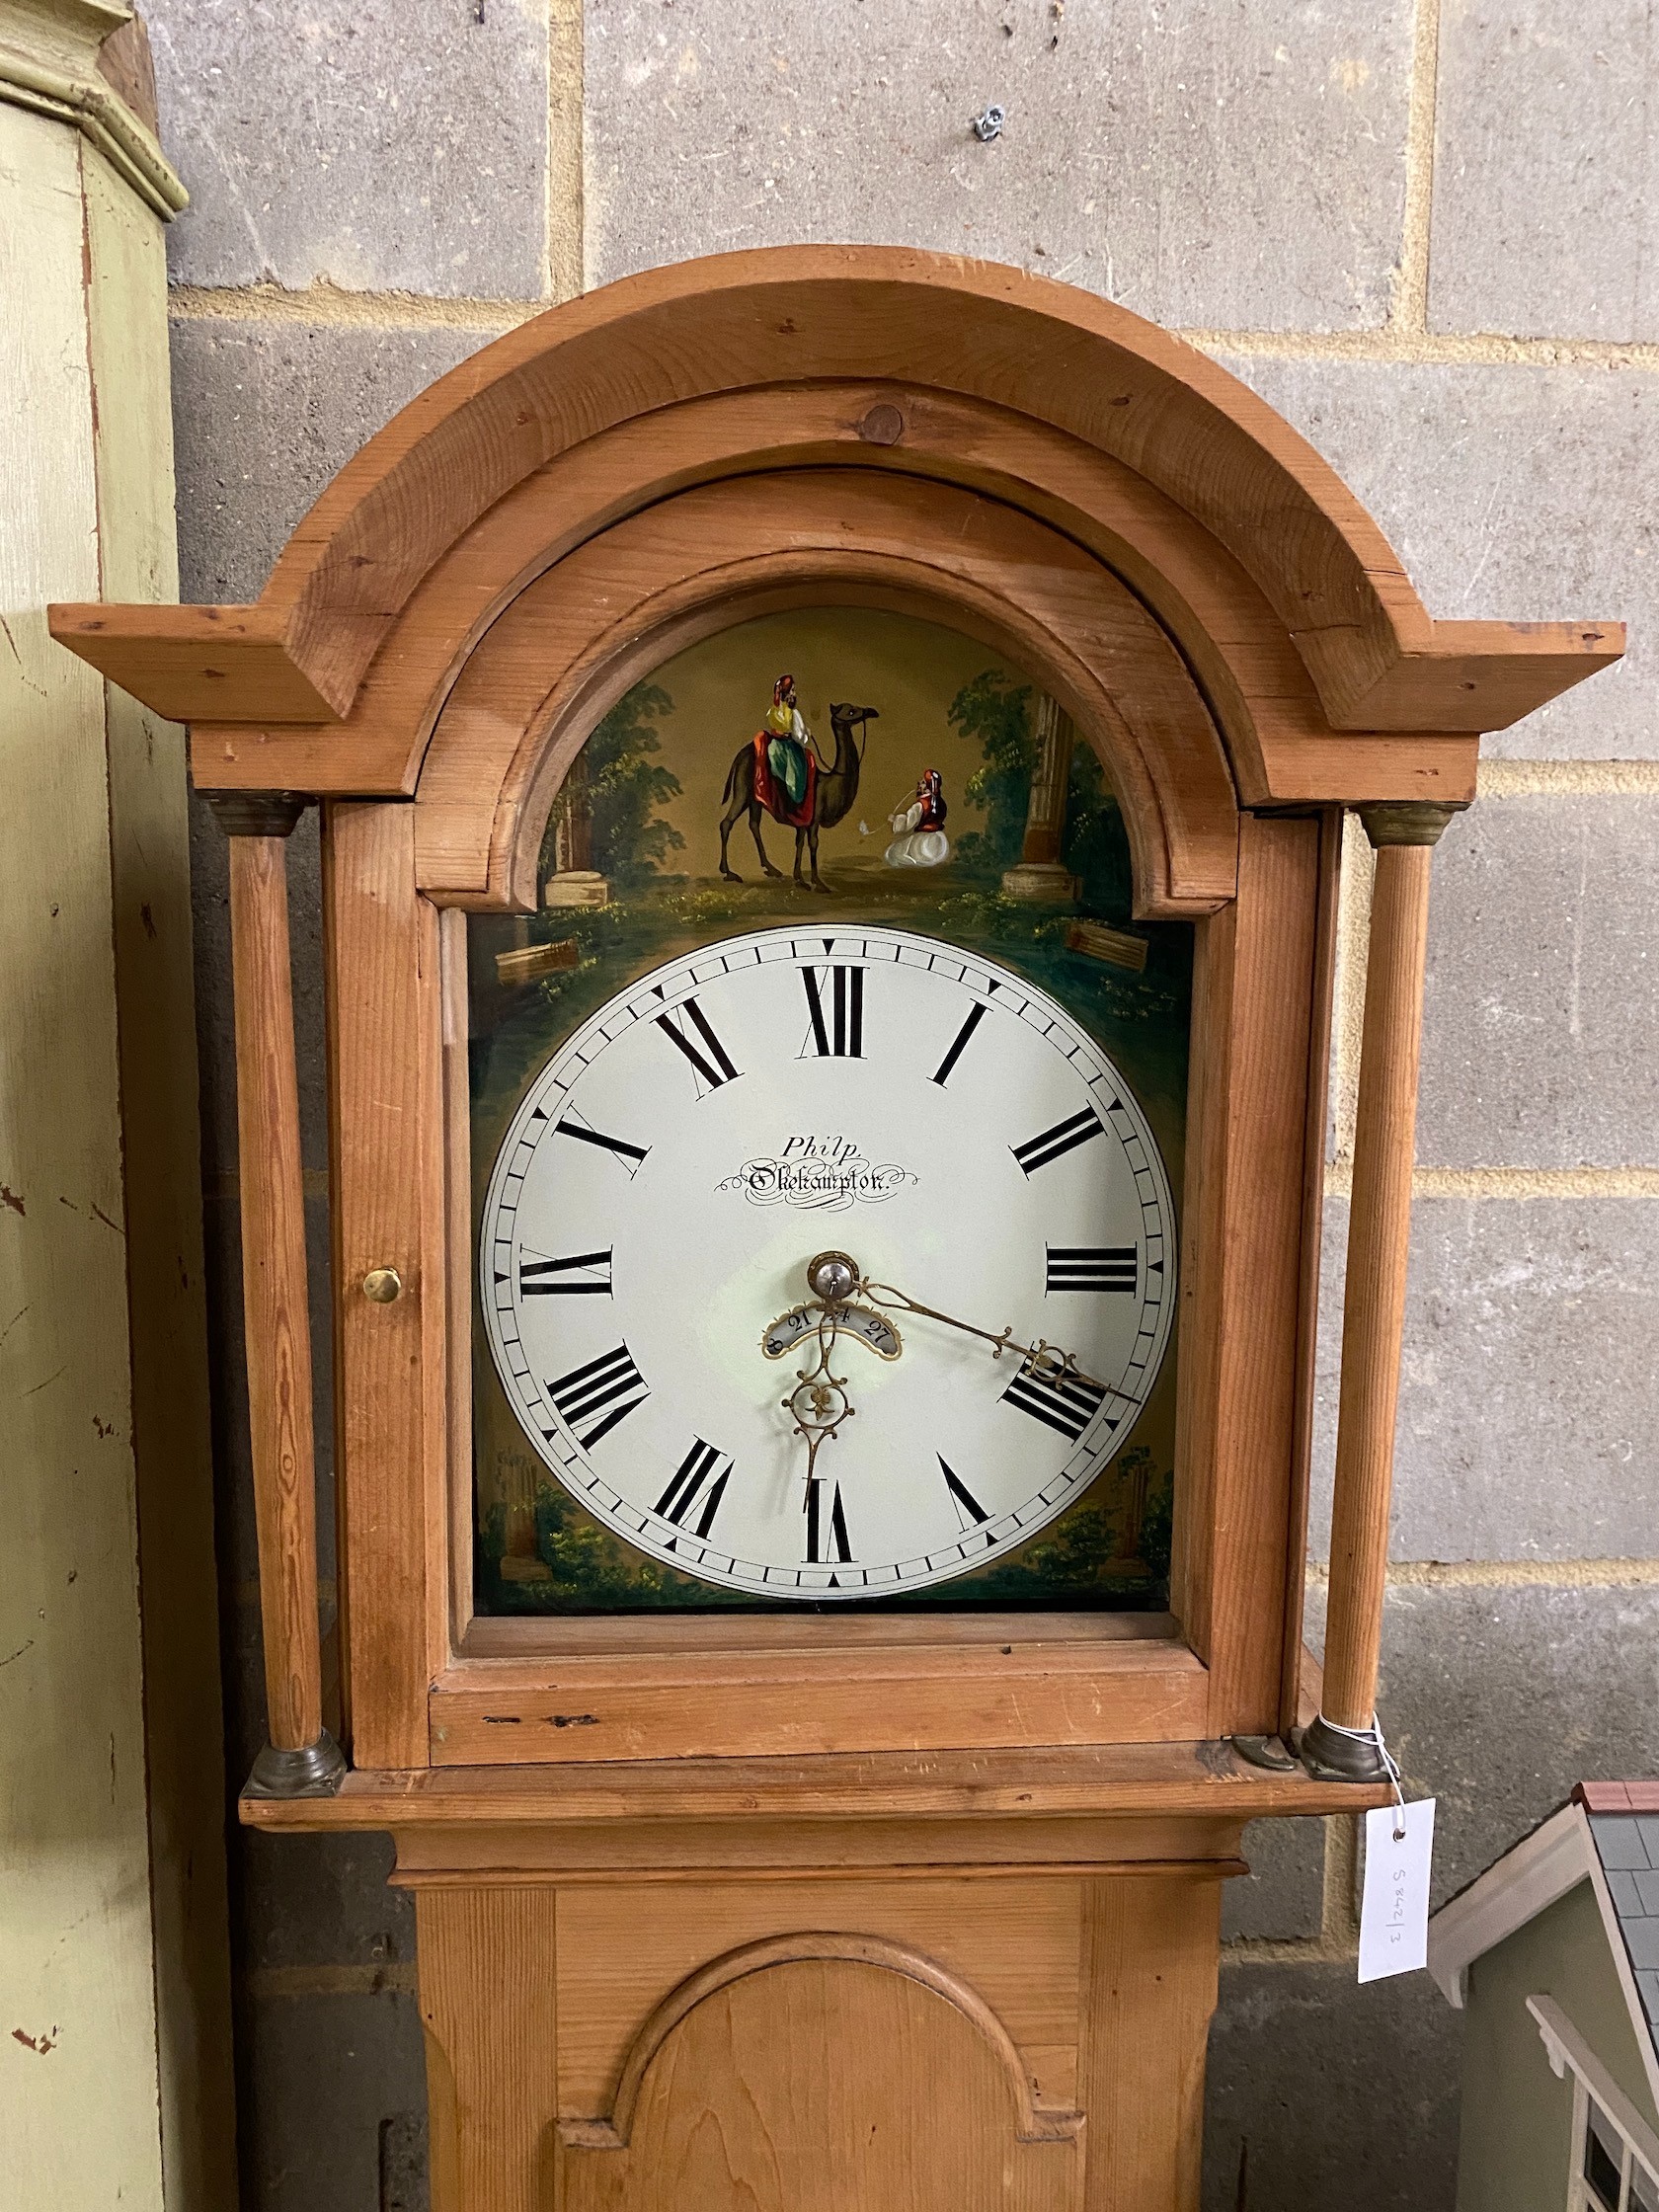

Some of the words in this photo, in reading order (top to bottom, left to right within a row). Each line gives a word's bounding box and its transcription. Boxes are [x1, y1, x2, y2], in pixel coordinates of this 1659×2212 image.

[649, 994, 745, 1101] XI
[794, 965, 870, 1060] XII
[926, 997, 993, 1089] I
[551, 1099, 652, 1180] X
[780, 1135, 862, 1166] Philp.
[1007, 1099, 1108, 1181] II
[519, 1243, 613, 1303] IX
[1045, 1240, 1138, 1299] III
[787, 1309, 812, 1331] 21
[863, 1319, 891, 1343] 27
[543, 1338, 652, 1456] VIII
[648, 1434, 735, 1541] VII
[801, 1477, 859, 1563] VI
[936, 1451, 995, 1535] V
